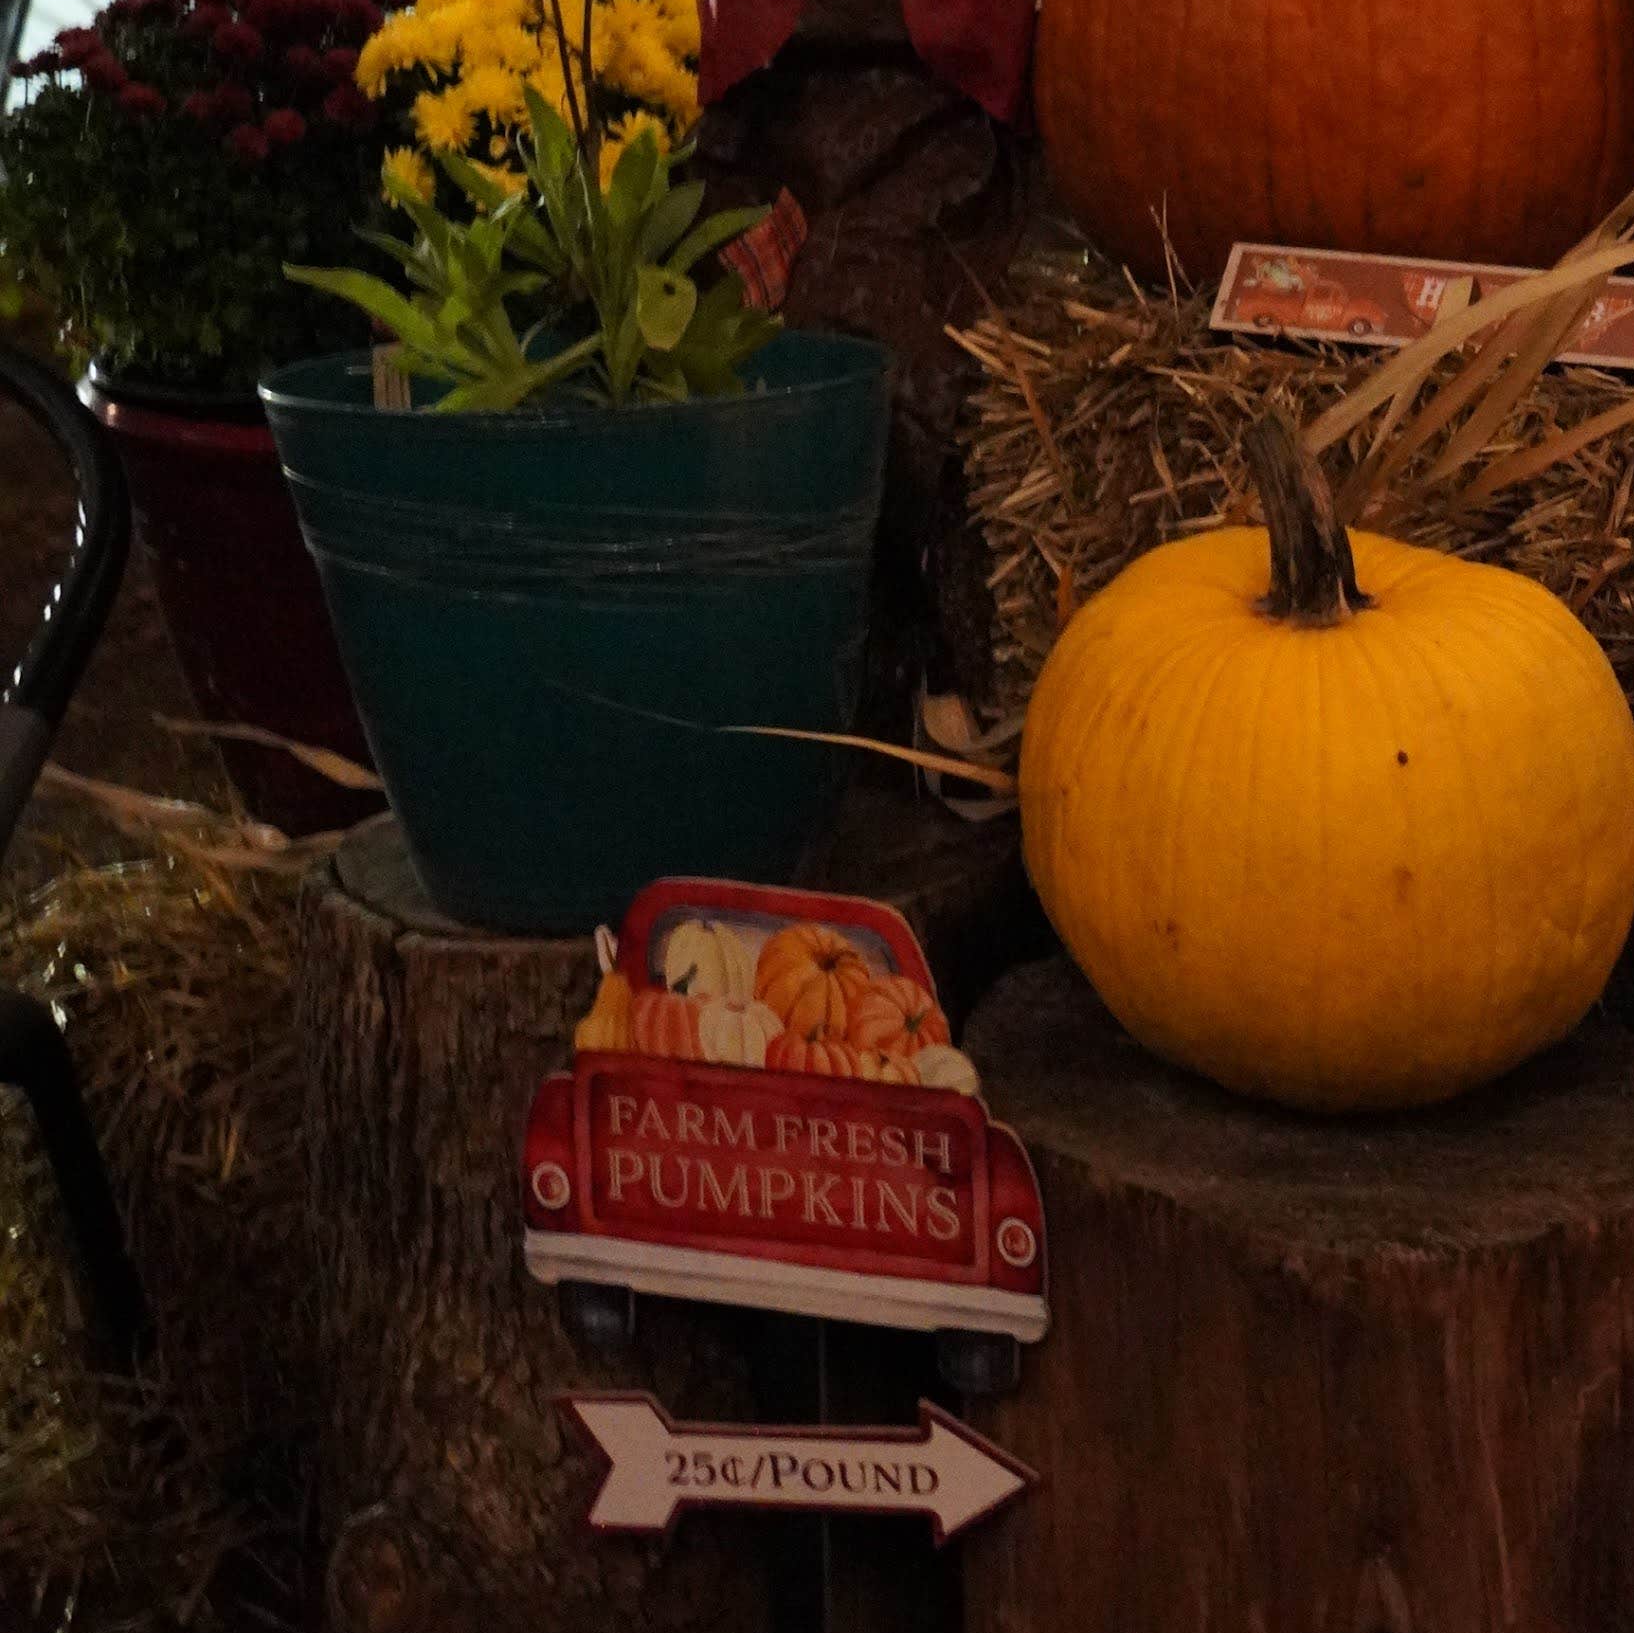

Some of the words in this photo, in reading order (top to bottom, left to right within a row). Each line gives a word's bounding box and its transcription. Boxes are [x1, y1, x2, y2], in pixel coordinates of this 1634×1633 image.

[606, 1094, 757, 1153] FARM
[774, 1112, 953, 1175] FRESH
[606, 1145, 962, 1242] PUMPKINS
